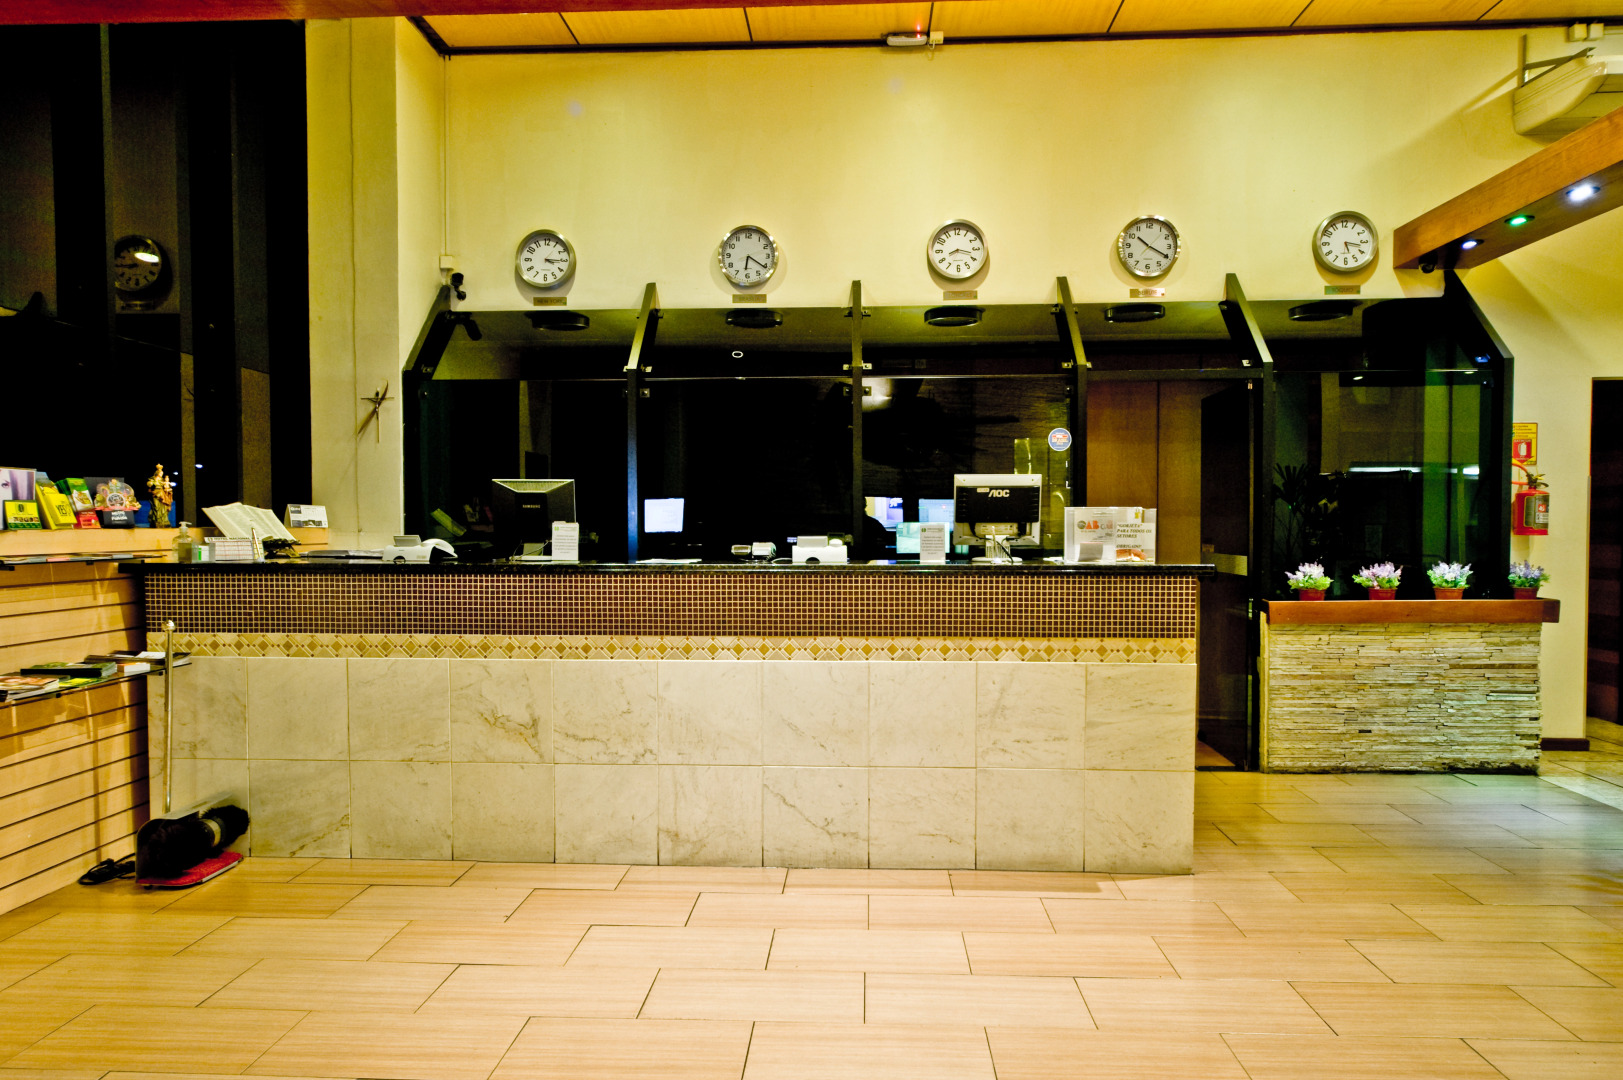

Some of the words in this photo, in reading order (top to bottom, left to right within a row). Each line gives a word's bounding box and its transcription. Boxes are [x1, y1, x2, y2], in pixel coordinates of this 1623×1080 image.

[1330, 223, 1338, 231] 11
[1341, 220, 1348, 228] 12
[944, 230, 951, 239] 11
[1324, 230, 1333, 238] 10
[534, 240, 541, 248] 11
[544, 238, 551, 246] 12
[936, 237, 946, 246] 10
[526, 246, 536, 254] 10
[1343, 257, 1348, 266] 6
[988, 489, 1010, 497] AOC
